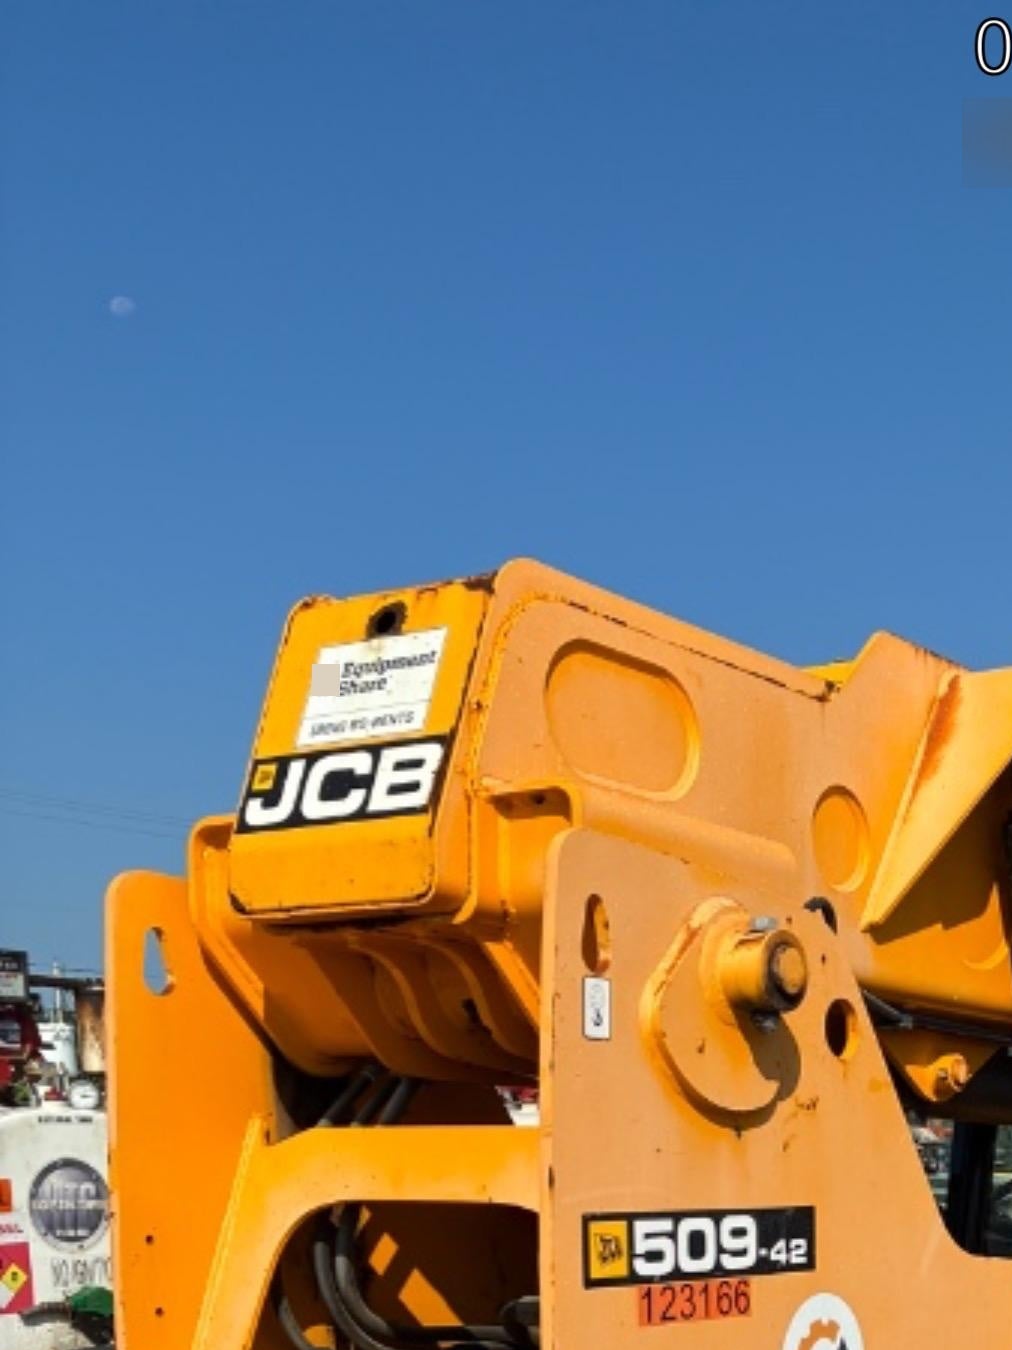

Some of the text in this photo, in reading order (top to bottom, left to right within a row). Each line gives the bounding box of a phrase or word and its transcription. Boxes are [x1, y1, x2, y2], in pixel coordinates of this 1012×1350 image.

[341, 650, 437, 678] Equipment
[338, 677, 387, 696] Share
[245, 743, 444, 827] JCB
[631, 1214, 808, 1277] 509-42
[641, 1281, 750, 1323] 123166
